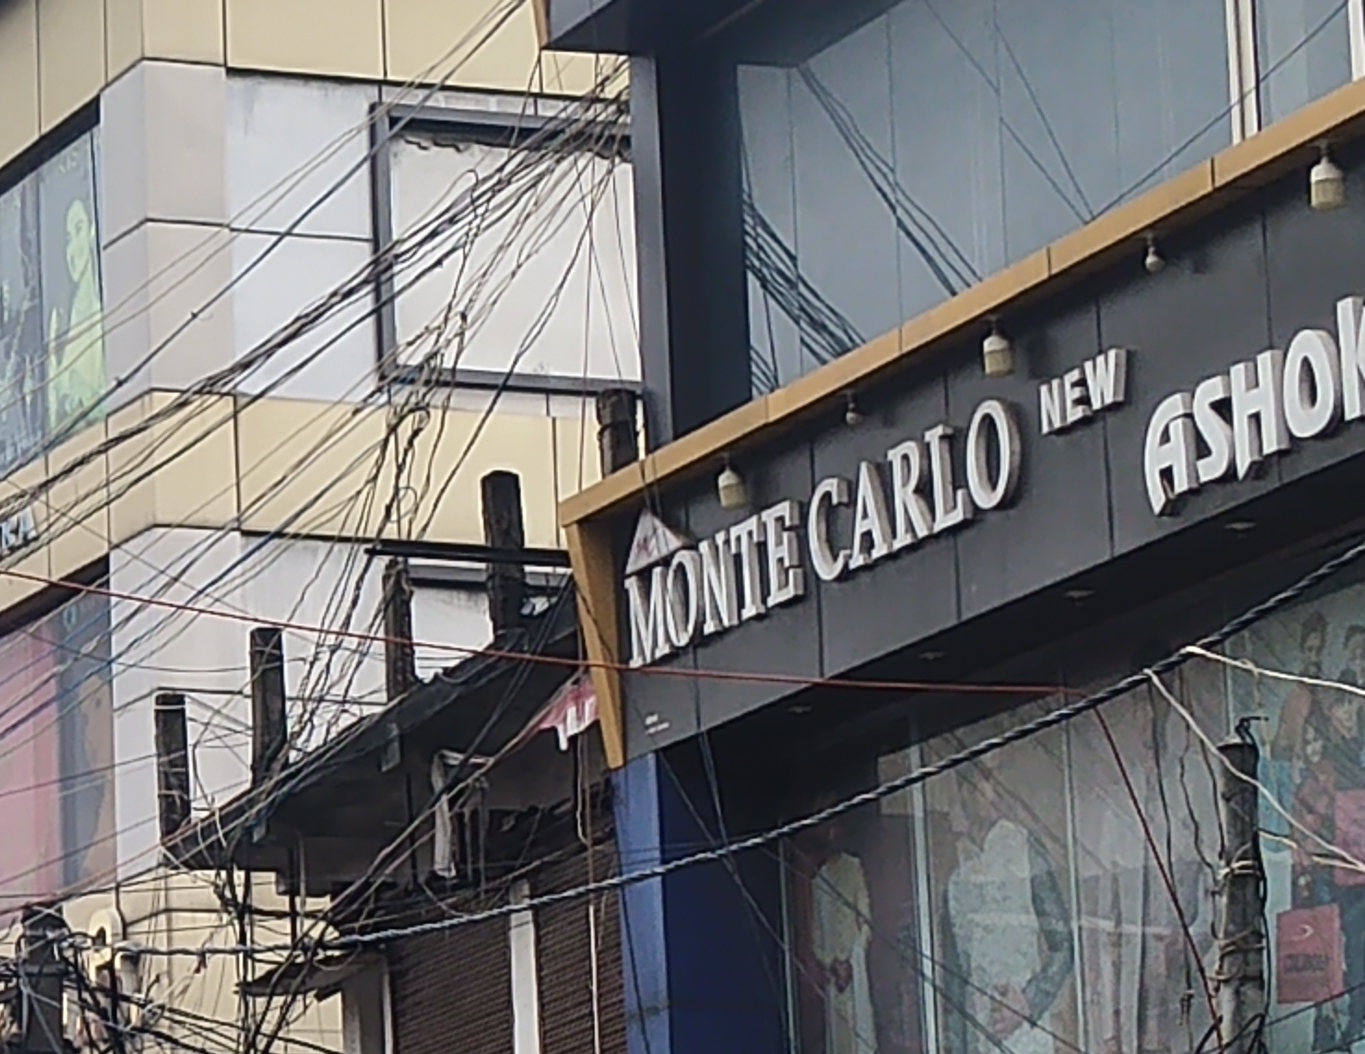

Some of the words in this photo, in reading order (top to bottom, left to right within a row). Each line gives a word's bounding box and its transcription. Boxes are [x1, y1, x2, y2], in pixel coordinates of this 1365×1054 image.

[1039, 347, 1127, 436] NEW
[624, 500, 805, 669] MONTE
[807, 400, 1027, 582] CARLO
